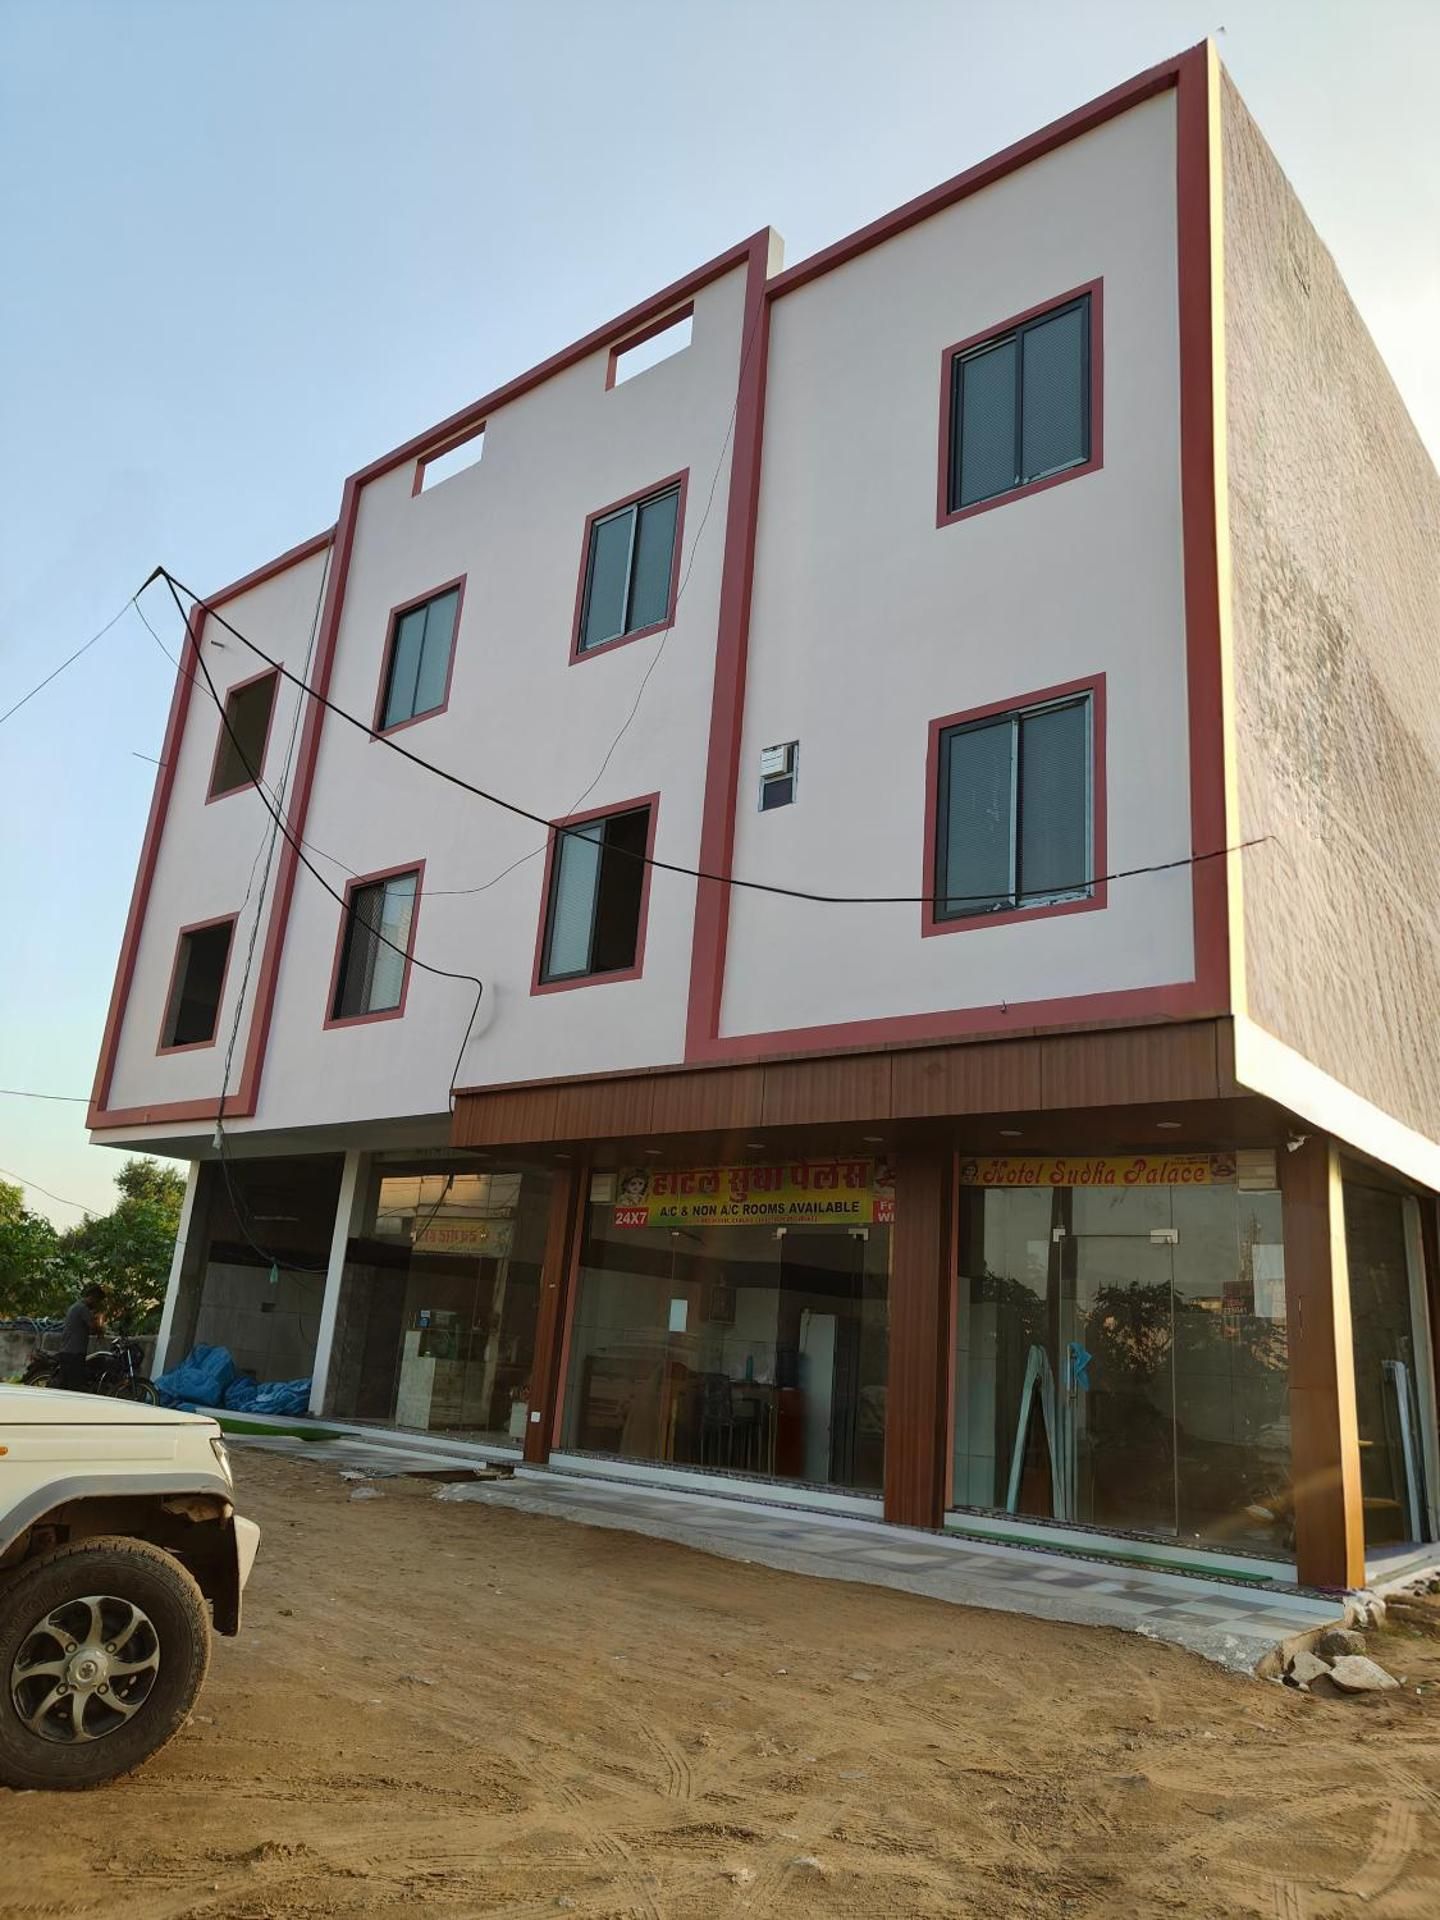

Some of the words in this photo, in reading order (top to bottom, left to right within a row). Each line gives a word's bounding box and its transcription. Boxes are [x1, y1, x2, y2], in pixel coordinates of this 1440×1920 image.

[983, 1160, 1045, 1184] Hotel
[1050, 1160, 1116, 1184] Sudha
[1123, 1159, 1206, 1184] Palace
[681, 1206, 689, 1217] &
[692, 1205, 717, 1216] NON
[743, 1202, 785, 1215] ROOMS
[788, 1201, 861, 1214] AVAILABLE
[880, 1201, 895, 1211] Fr
